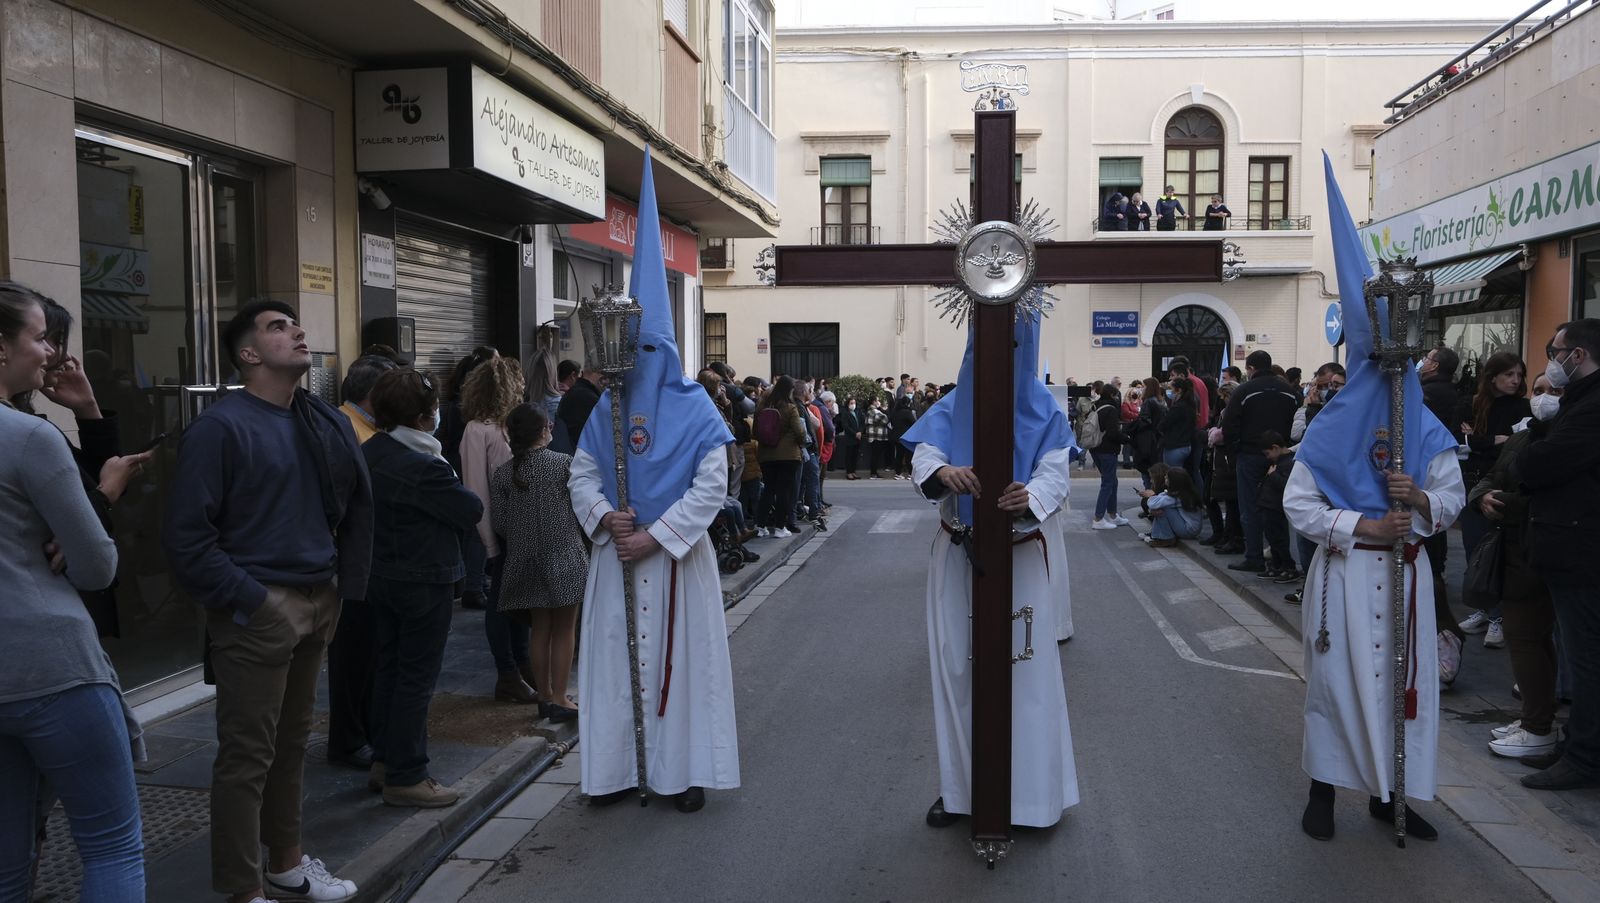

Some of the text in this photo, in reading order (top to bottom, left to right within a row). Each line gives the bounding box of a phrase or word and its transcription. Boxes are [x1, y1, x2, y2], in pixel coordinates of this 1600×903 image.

[361, 133, 445, 146] TALLER DE JOYERÍA
[480, 96, 600, 178] Alejandro Artesanos
[528, 159, 600, 203] TALLER DE JOYERÍA
[306, 206, 317, 223] 15
[1412, 164, 1600, 253] Floristería CARM
[368, 237, 390, 250] HORARIO
[1105, 320, 1136, 329] Milagrosa
